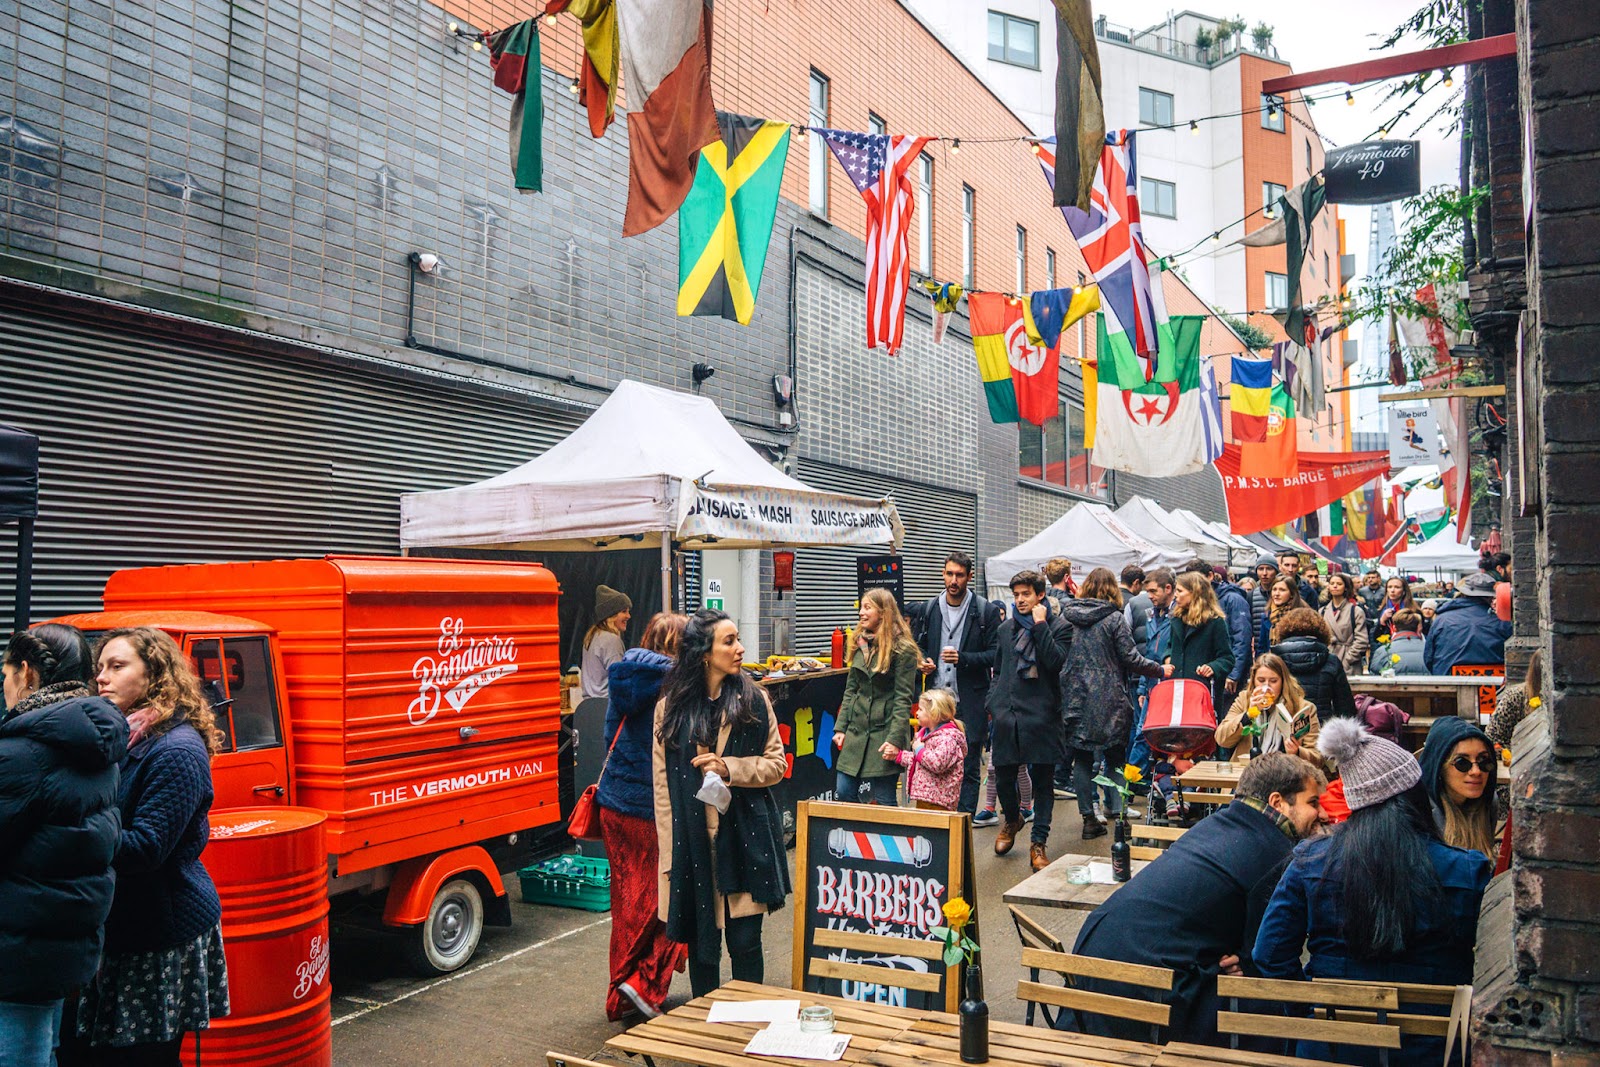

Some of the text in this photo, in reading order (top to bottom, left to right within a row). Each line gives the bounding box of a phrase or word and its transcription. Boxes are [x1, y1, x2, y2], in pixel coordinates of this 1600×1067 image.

[1332, 144, 1412, 169] Vermouth
[1358, 160, 1384, 180] 49
[1284, 469, 1326, 487] BARGE
[758, 504, 792, 524] MASH
[811, 509, 858, 527] SAUSAGE
[438, 617, 463, 657] El
[407, 635, 518, 725] Bandarra
[455, 667, 504, 702] VERMUT
[370, 761, 543, 806] THE VERMOUTH VAN
[817, 865, 945, 933] BARBERS
[310, 935, 321, 960] El
[841, 979, 907, 1008] OPEN
